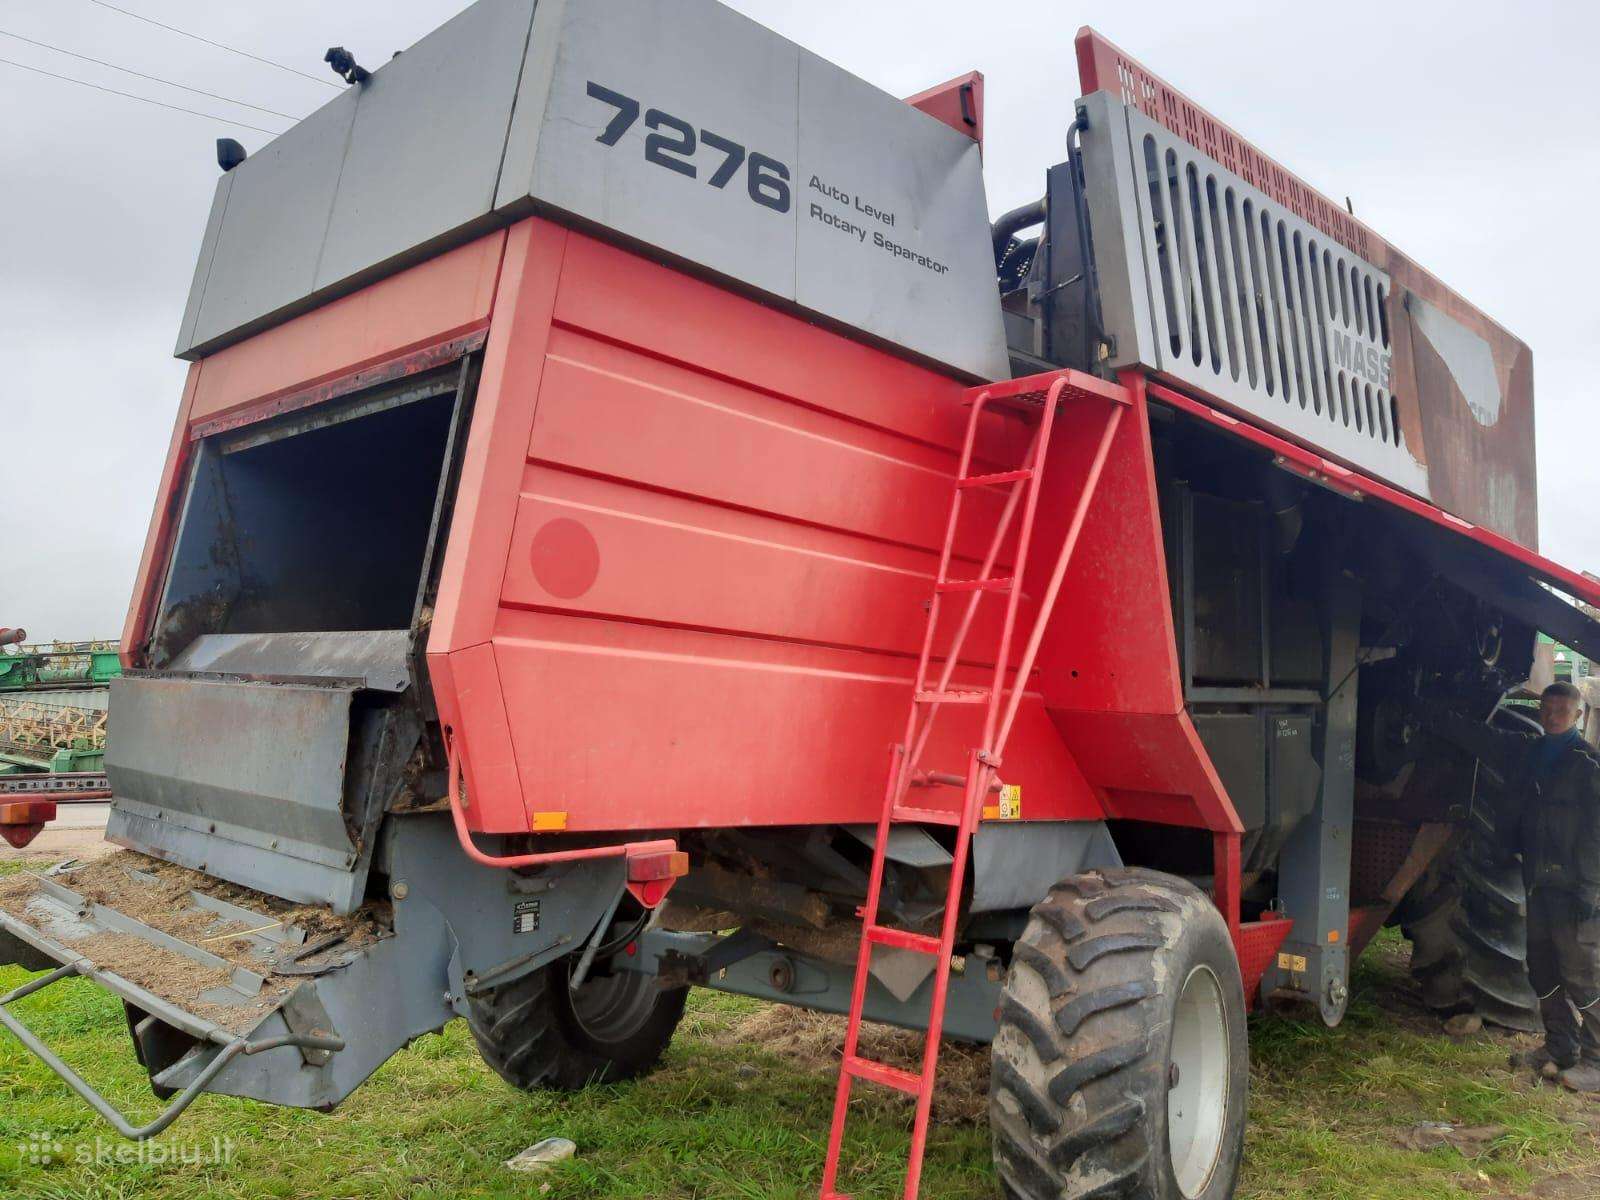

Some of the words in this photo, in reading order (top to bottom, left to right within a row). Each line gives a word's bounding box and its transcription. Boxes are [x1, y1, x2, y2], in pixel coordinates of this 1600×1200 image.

[587, 80, 790, 213] 7276
[809, 175, 850, 205] Auto
[855, 196, 895, 227] Level
[810, 203, 867, 242] Rotary
[873, 231, 949, 274] Separator
